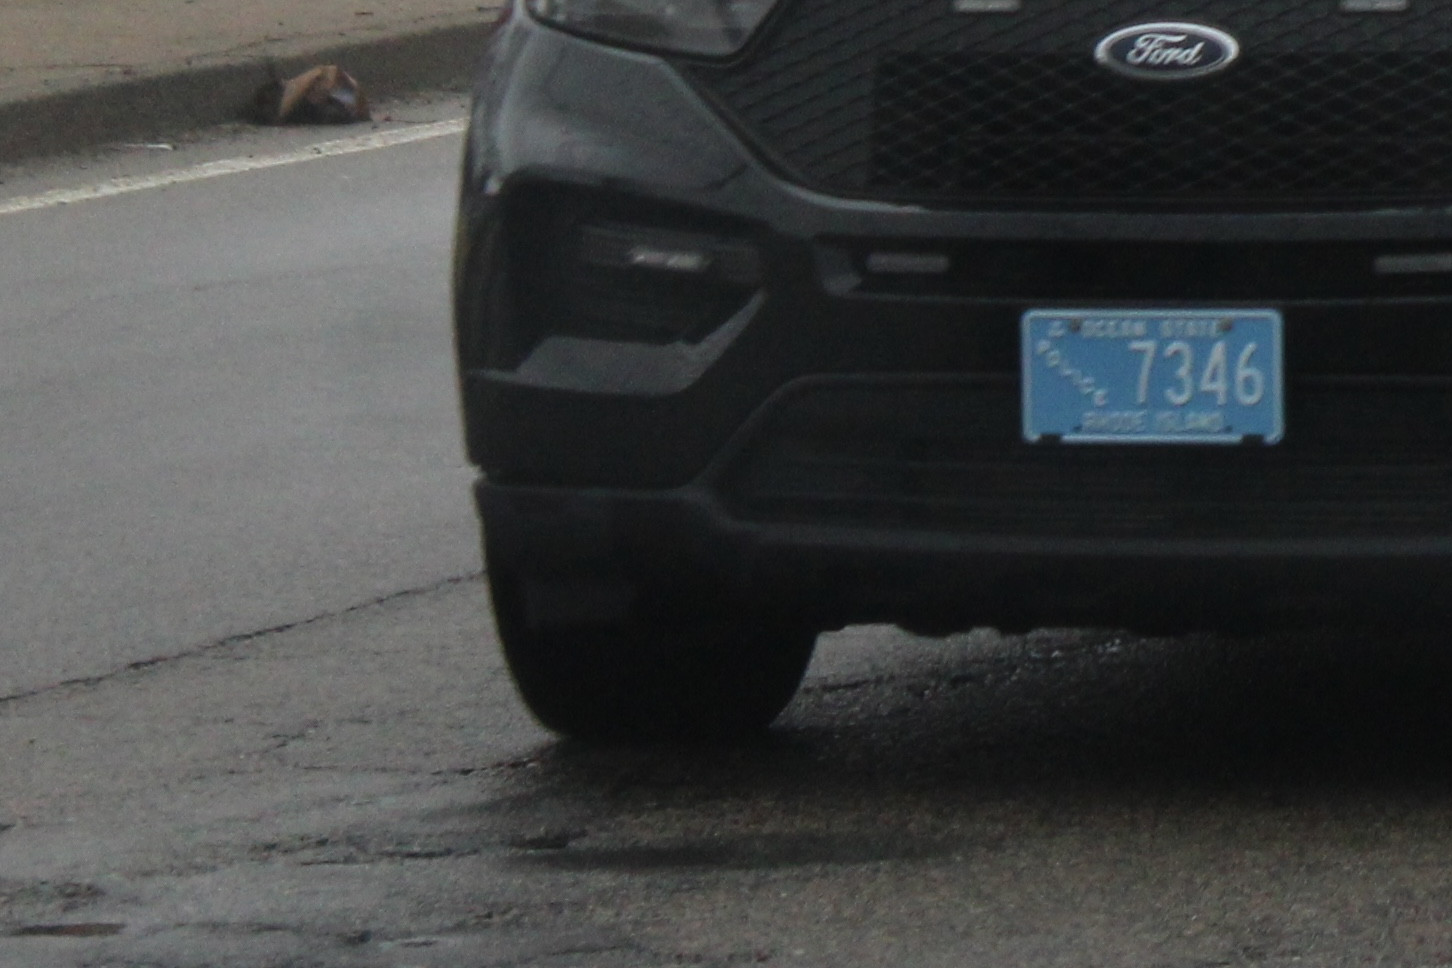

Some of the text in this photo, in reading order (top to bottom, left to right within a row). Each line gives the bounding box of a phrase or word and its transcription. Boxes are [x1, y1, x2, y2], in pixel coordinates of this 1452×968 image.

[1126, 34, 1206, 66] Ford
[1081, 320, 1222, 338] OCEAN STATE
[1036, 339, 1108, 407] POLICE
[1128, 340, 1265, 407] 7346
[1081, 410, 1224, 432] RHODE ISLAND
